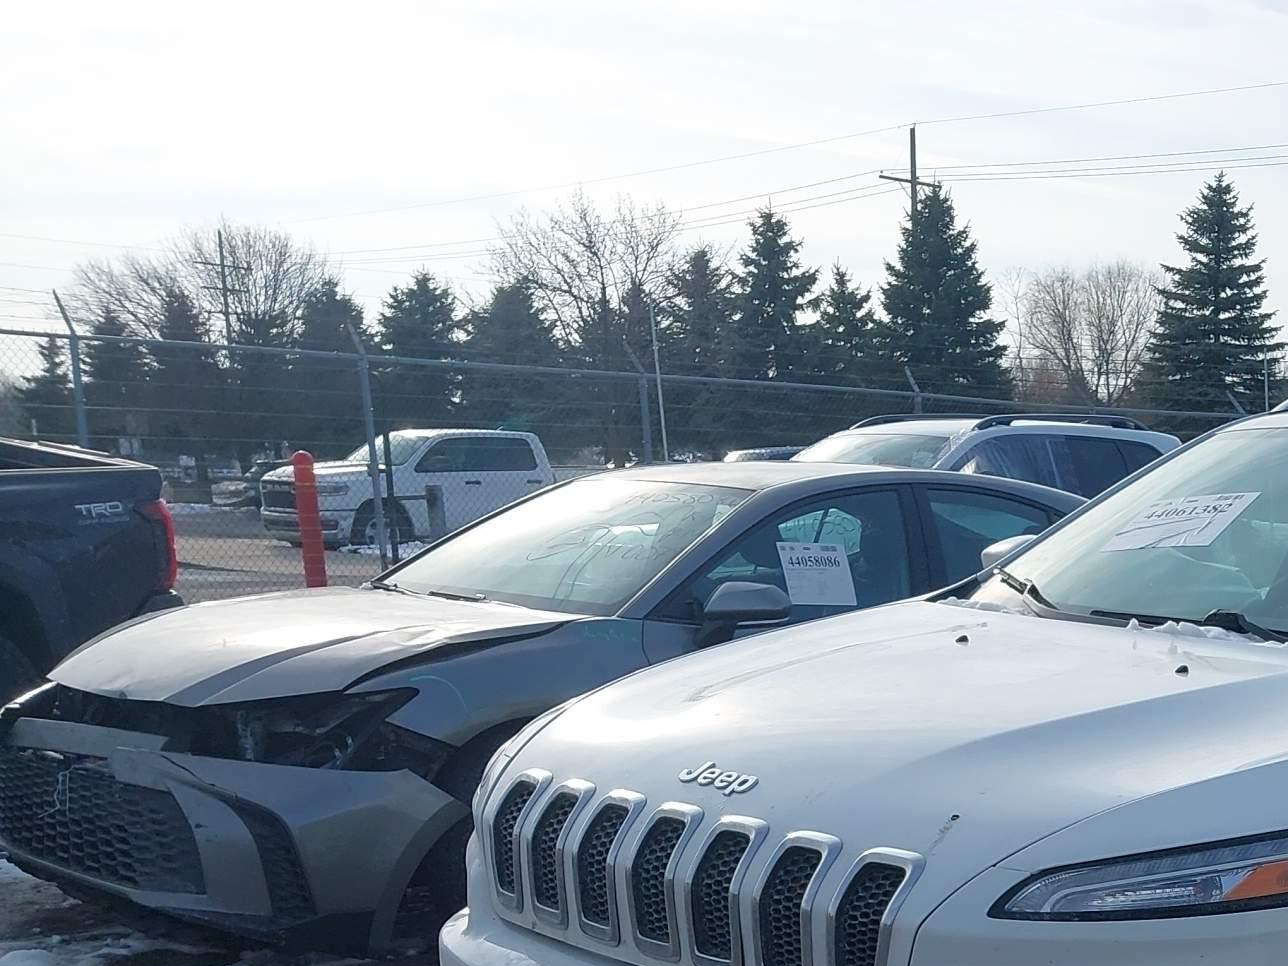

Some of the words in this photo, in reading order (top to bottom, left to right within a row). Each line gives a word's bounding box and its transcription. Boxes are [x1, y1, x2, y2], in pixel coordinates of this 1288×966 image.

[74, 501, 122, 518] TRD
[1144, 503, 1233, 520] 44061382
[787, 555, 841, 568] 44058086
[678, 760, 760, 797] Jeep
